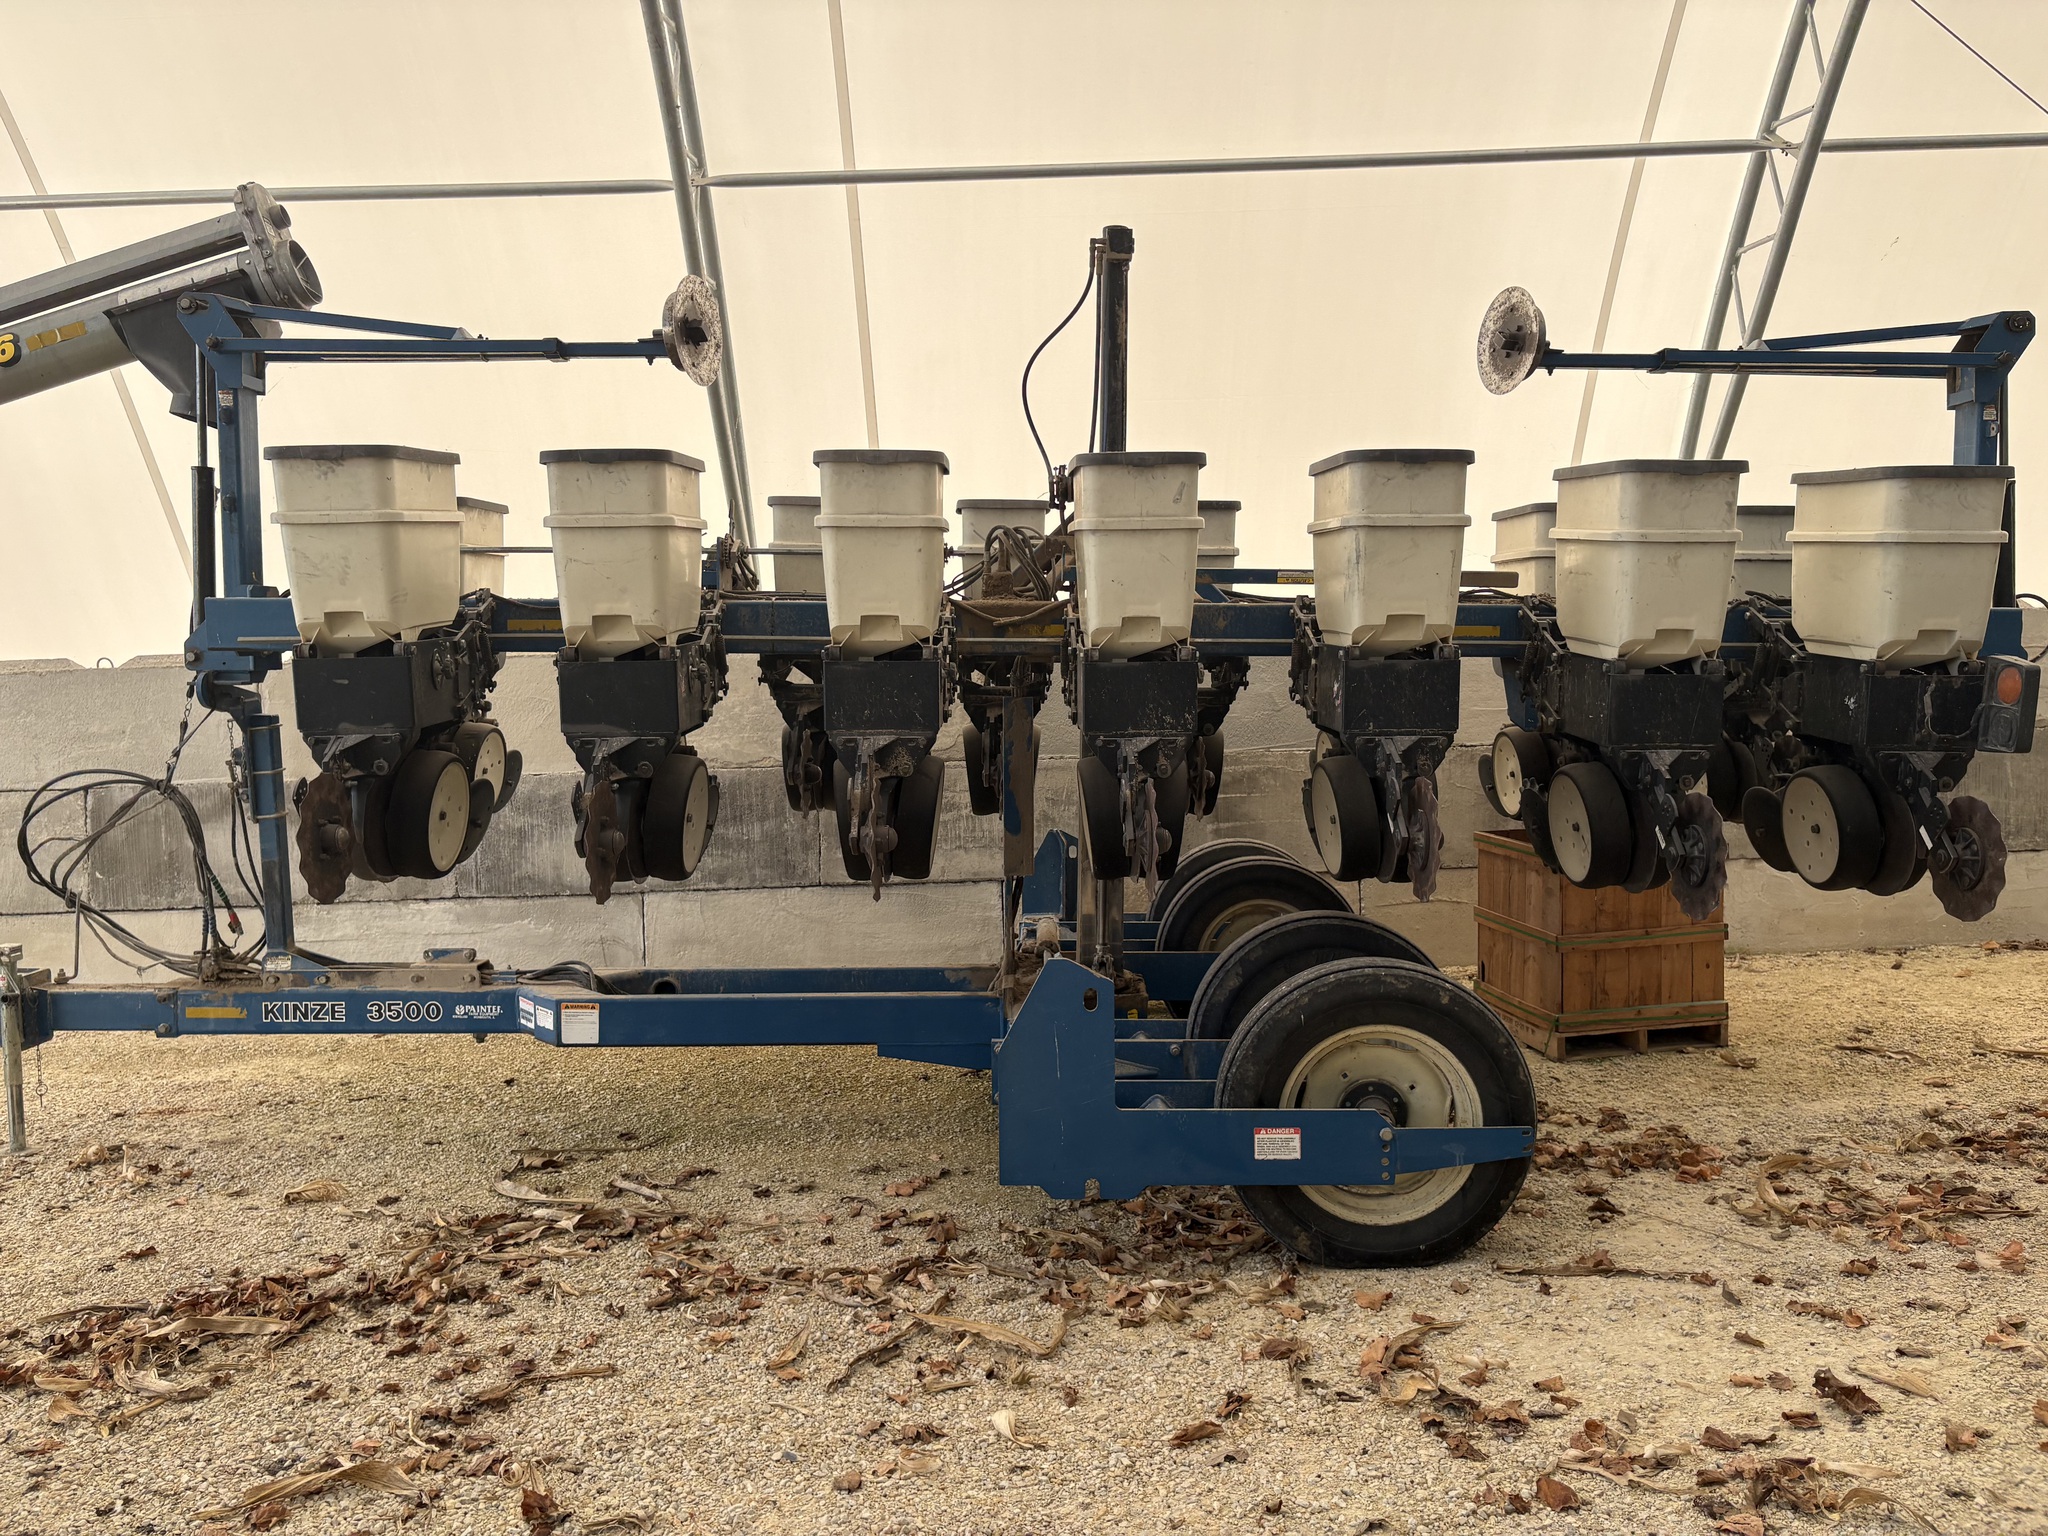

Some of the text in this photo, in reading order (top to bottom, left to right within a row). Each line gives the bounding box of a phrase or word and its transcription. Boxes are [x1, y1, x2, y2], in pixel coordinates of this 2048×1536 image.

[0, 333, 21, 367] 6
[262, 1000, 443, 1023] KINZE 3500
